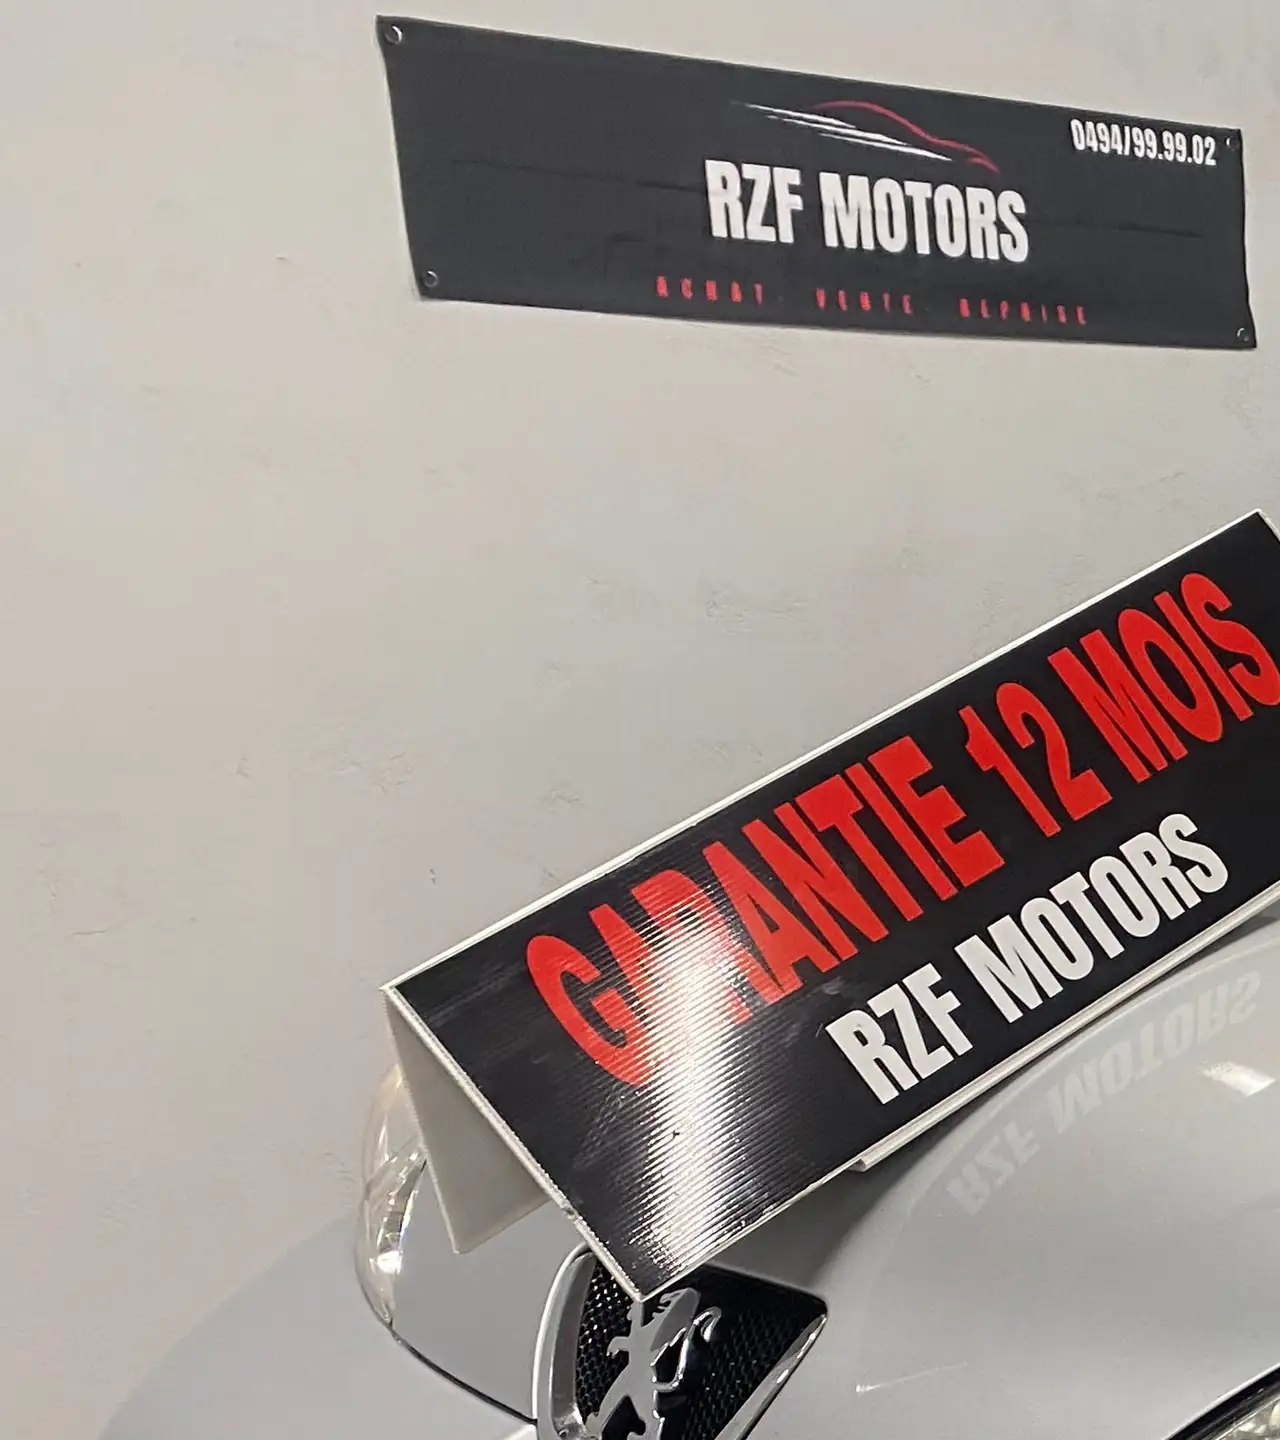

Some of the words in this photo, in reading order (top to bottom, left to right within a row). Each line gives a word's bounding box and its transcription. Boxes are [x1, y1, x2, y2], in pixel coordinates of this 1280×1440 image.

[705, 159, 804, 244] RZF
[818, 171, 1029, 263] MOTORS
[1070, 118, 1217, 166] 0494/99.99.02
[525, 735, 1006, 1085] GARANTIE
[958, 682, 1113, 838] 12
[824, 962, 974, 1105] RZF
[954, 813, 1229, 1024] MOTORS
